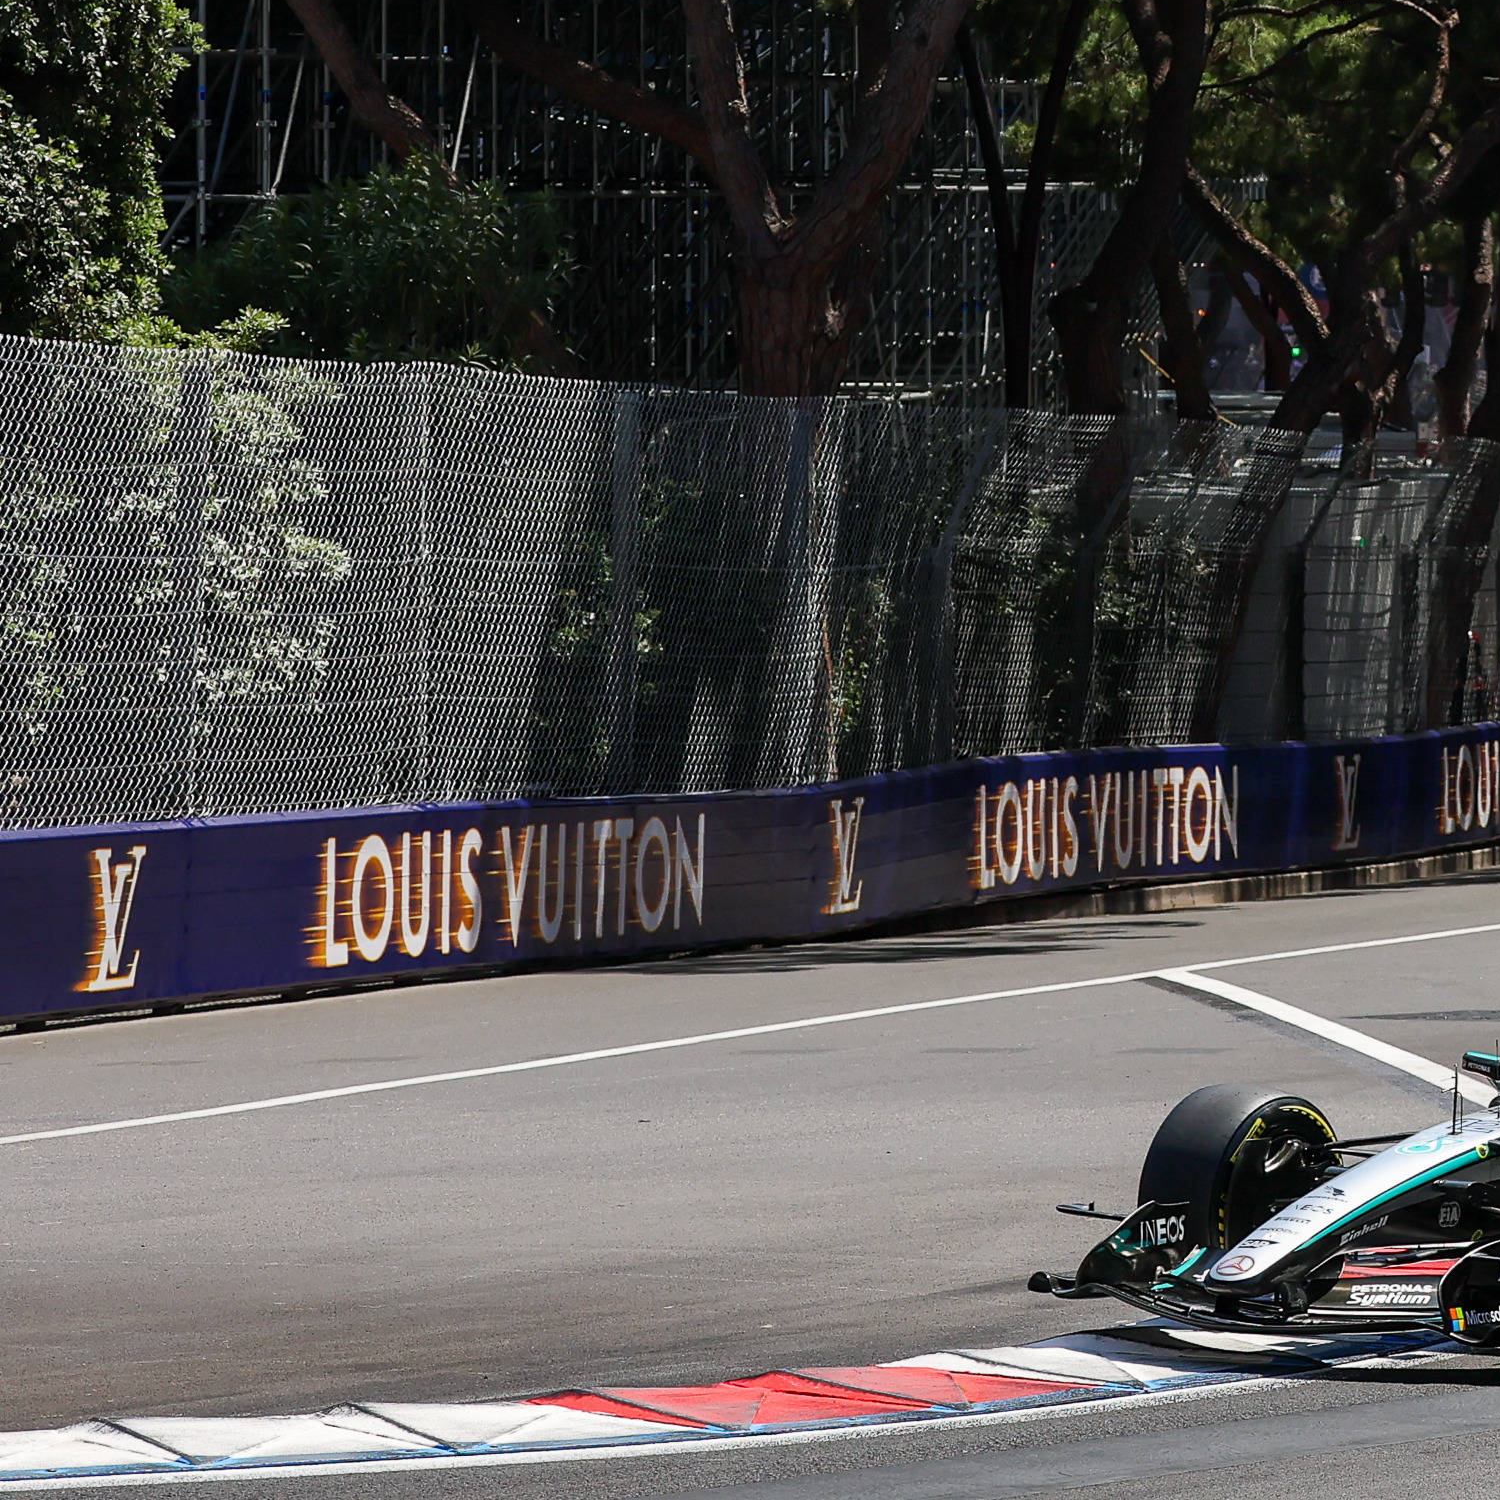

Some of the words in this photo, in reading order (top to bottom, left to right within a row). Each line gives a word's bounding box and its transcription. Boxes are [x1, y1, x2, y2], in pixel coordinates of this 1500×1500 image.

[980, 775, 1079, 889] LOUIS
[1089, 764, 1239, 873] VUITTON
[830, 797, 864, 914] LV
[325, 827, 482, 966] LOUIS
[502, 812, 705, 947] VUITTON
[88, 845, 147, 992] LV
[1140, 1214, 1186, 1248] INEOS
[1339, 1215, 1389, 1247] Einhell
[1440, 1205, 1460, 1227] FIA
[1346, 1291, 1431, 1307] Syntium
[1350, 1283, 1433, 1293] PETRONAS
